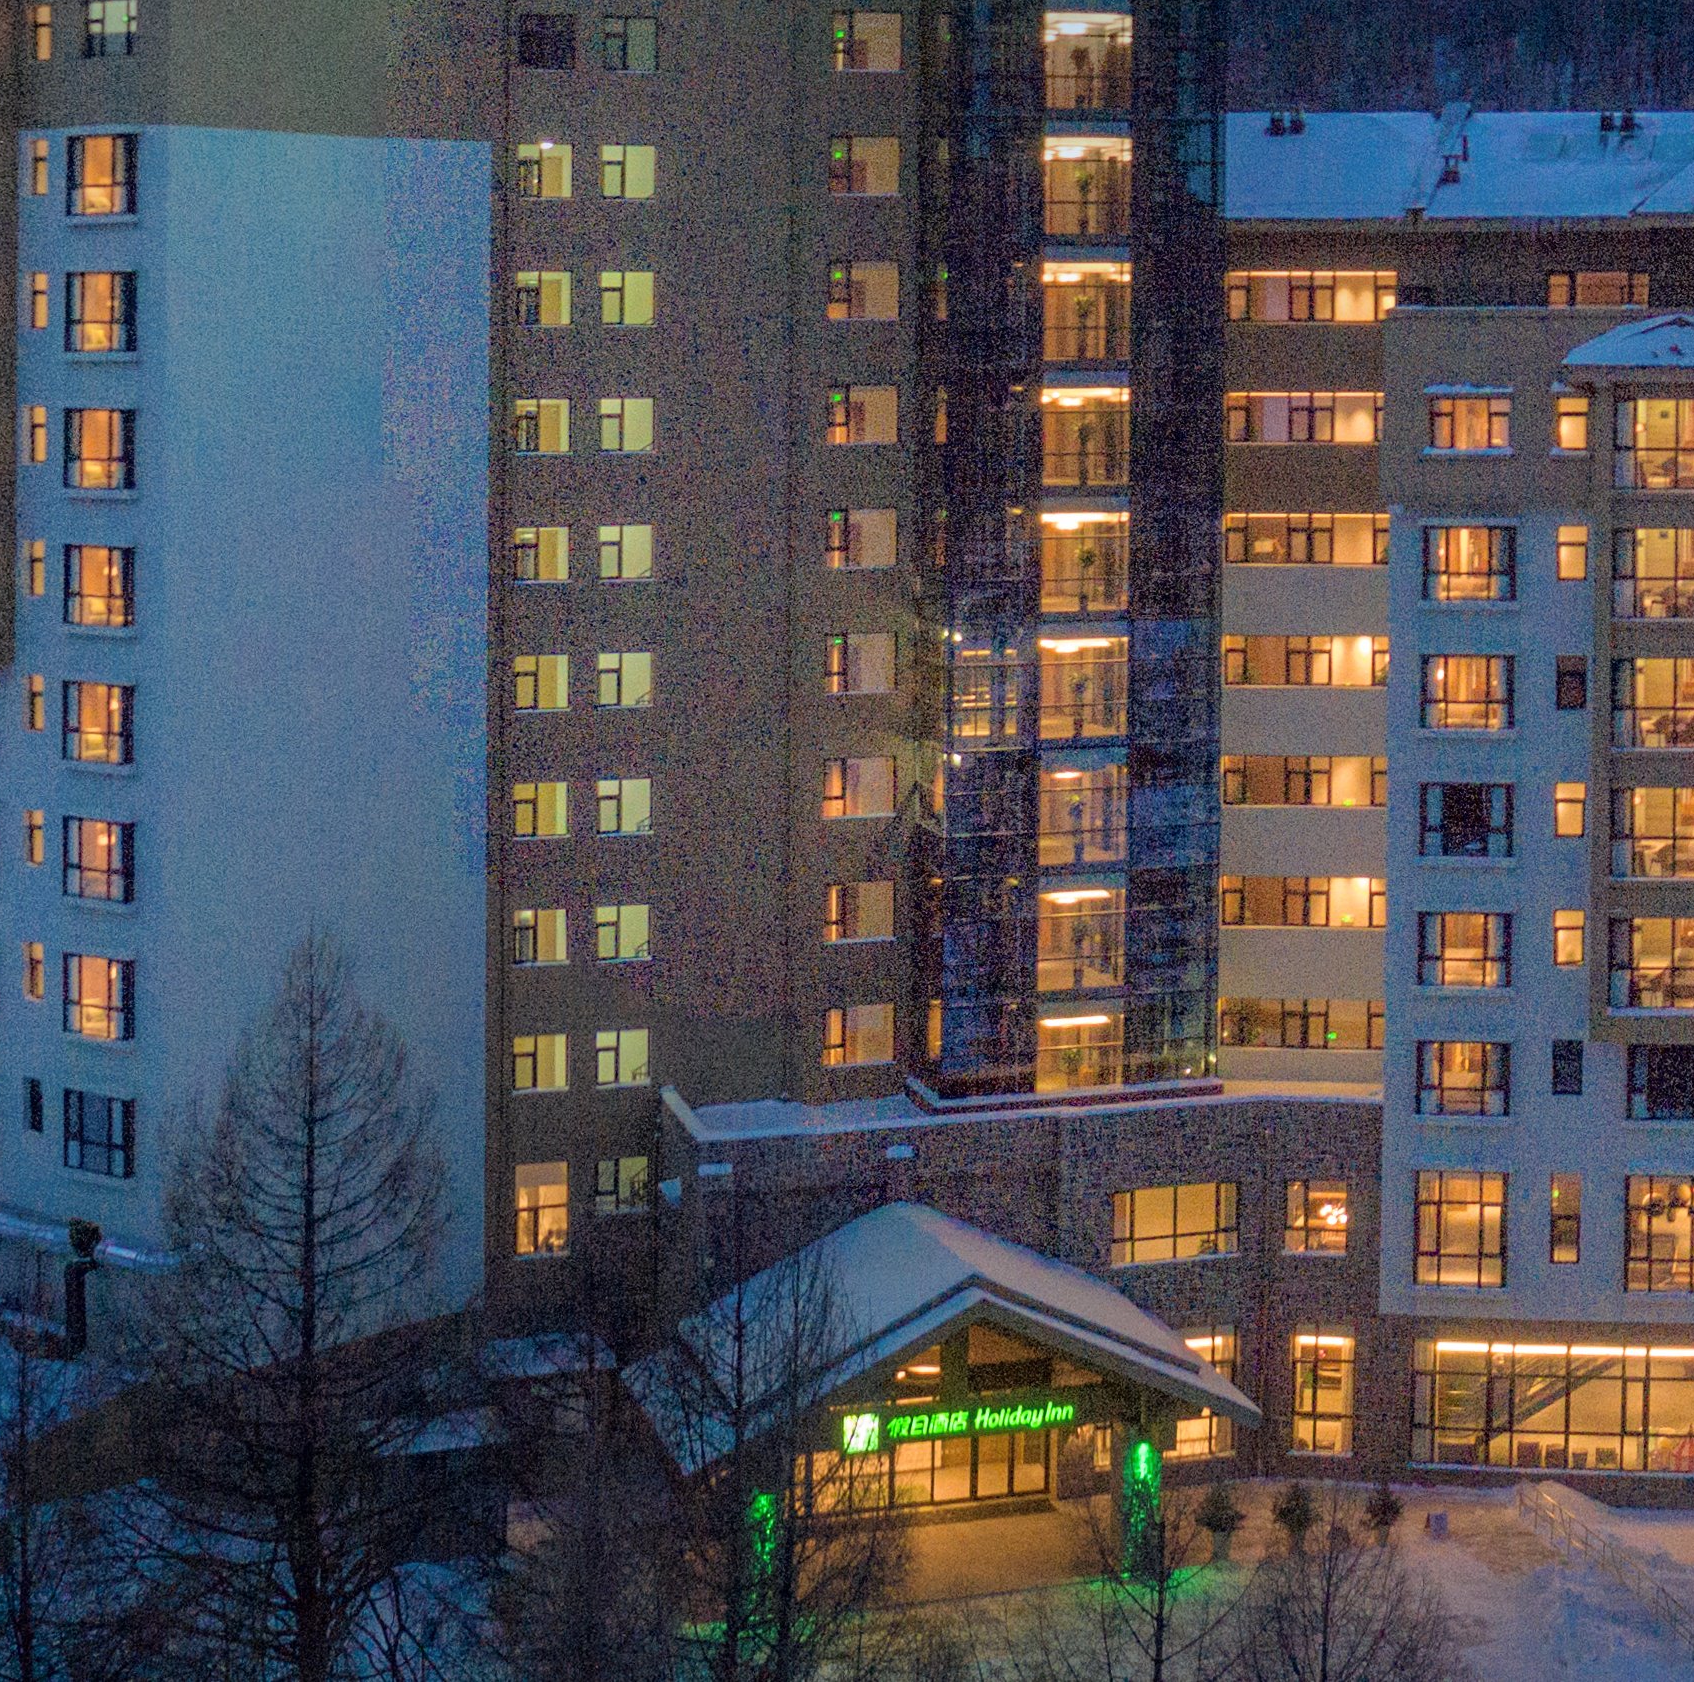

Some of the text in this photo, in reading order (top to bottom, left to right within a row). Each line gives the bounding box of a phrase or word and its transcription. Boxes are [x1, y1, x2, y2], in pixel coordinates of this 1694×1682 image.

[887, 1410, 969, 1437] 假日酒店
[974, 1401, 1074, 1429] Holiday Inn
